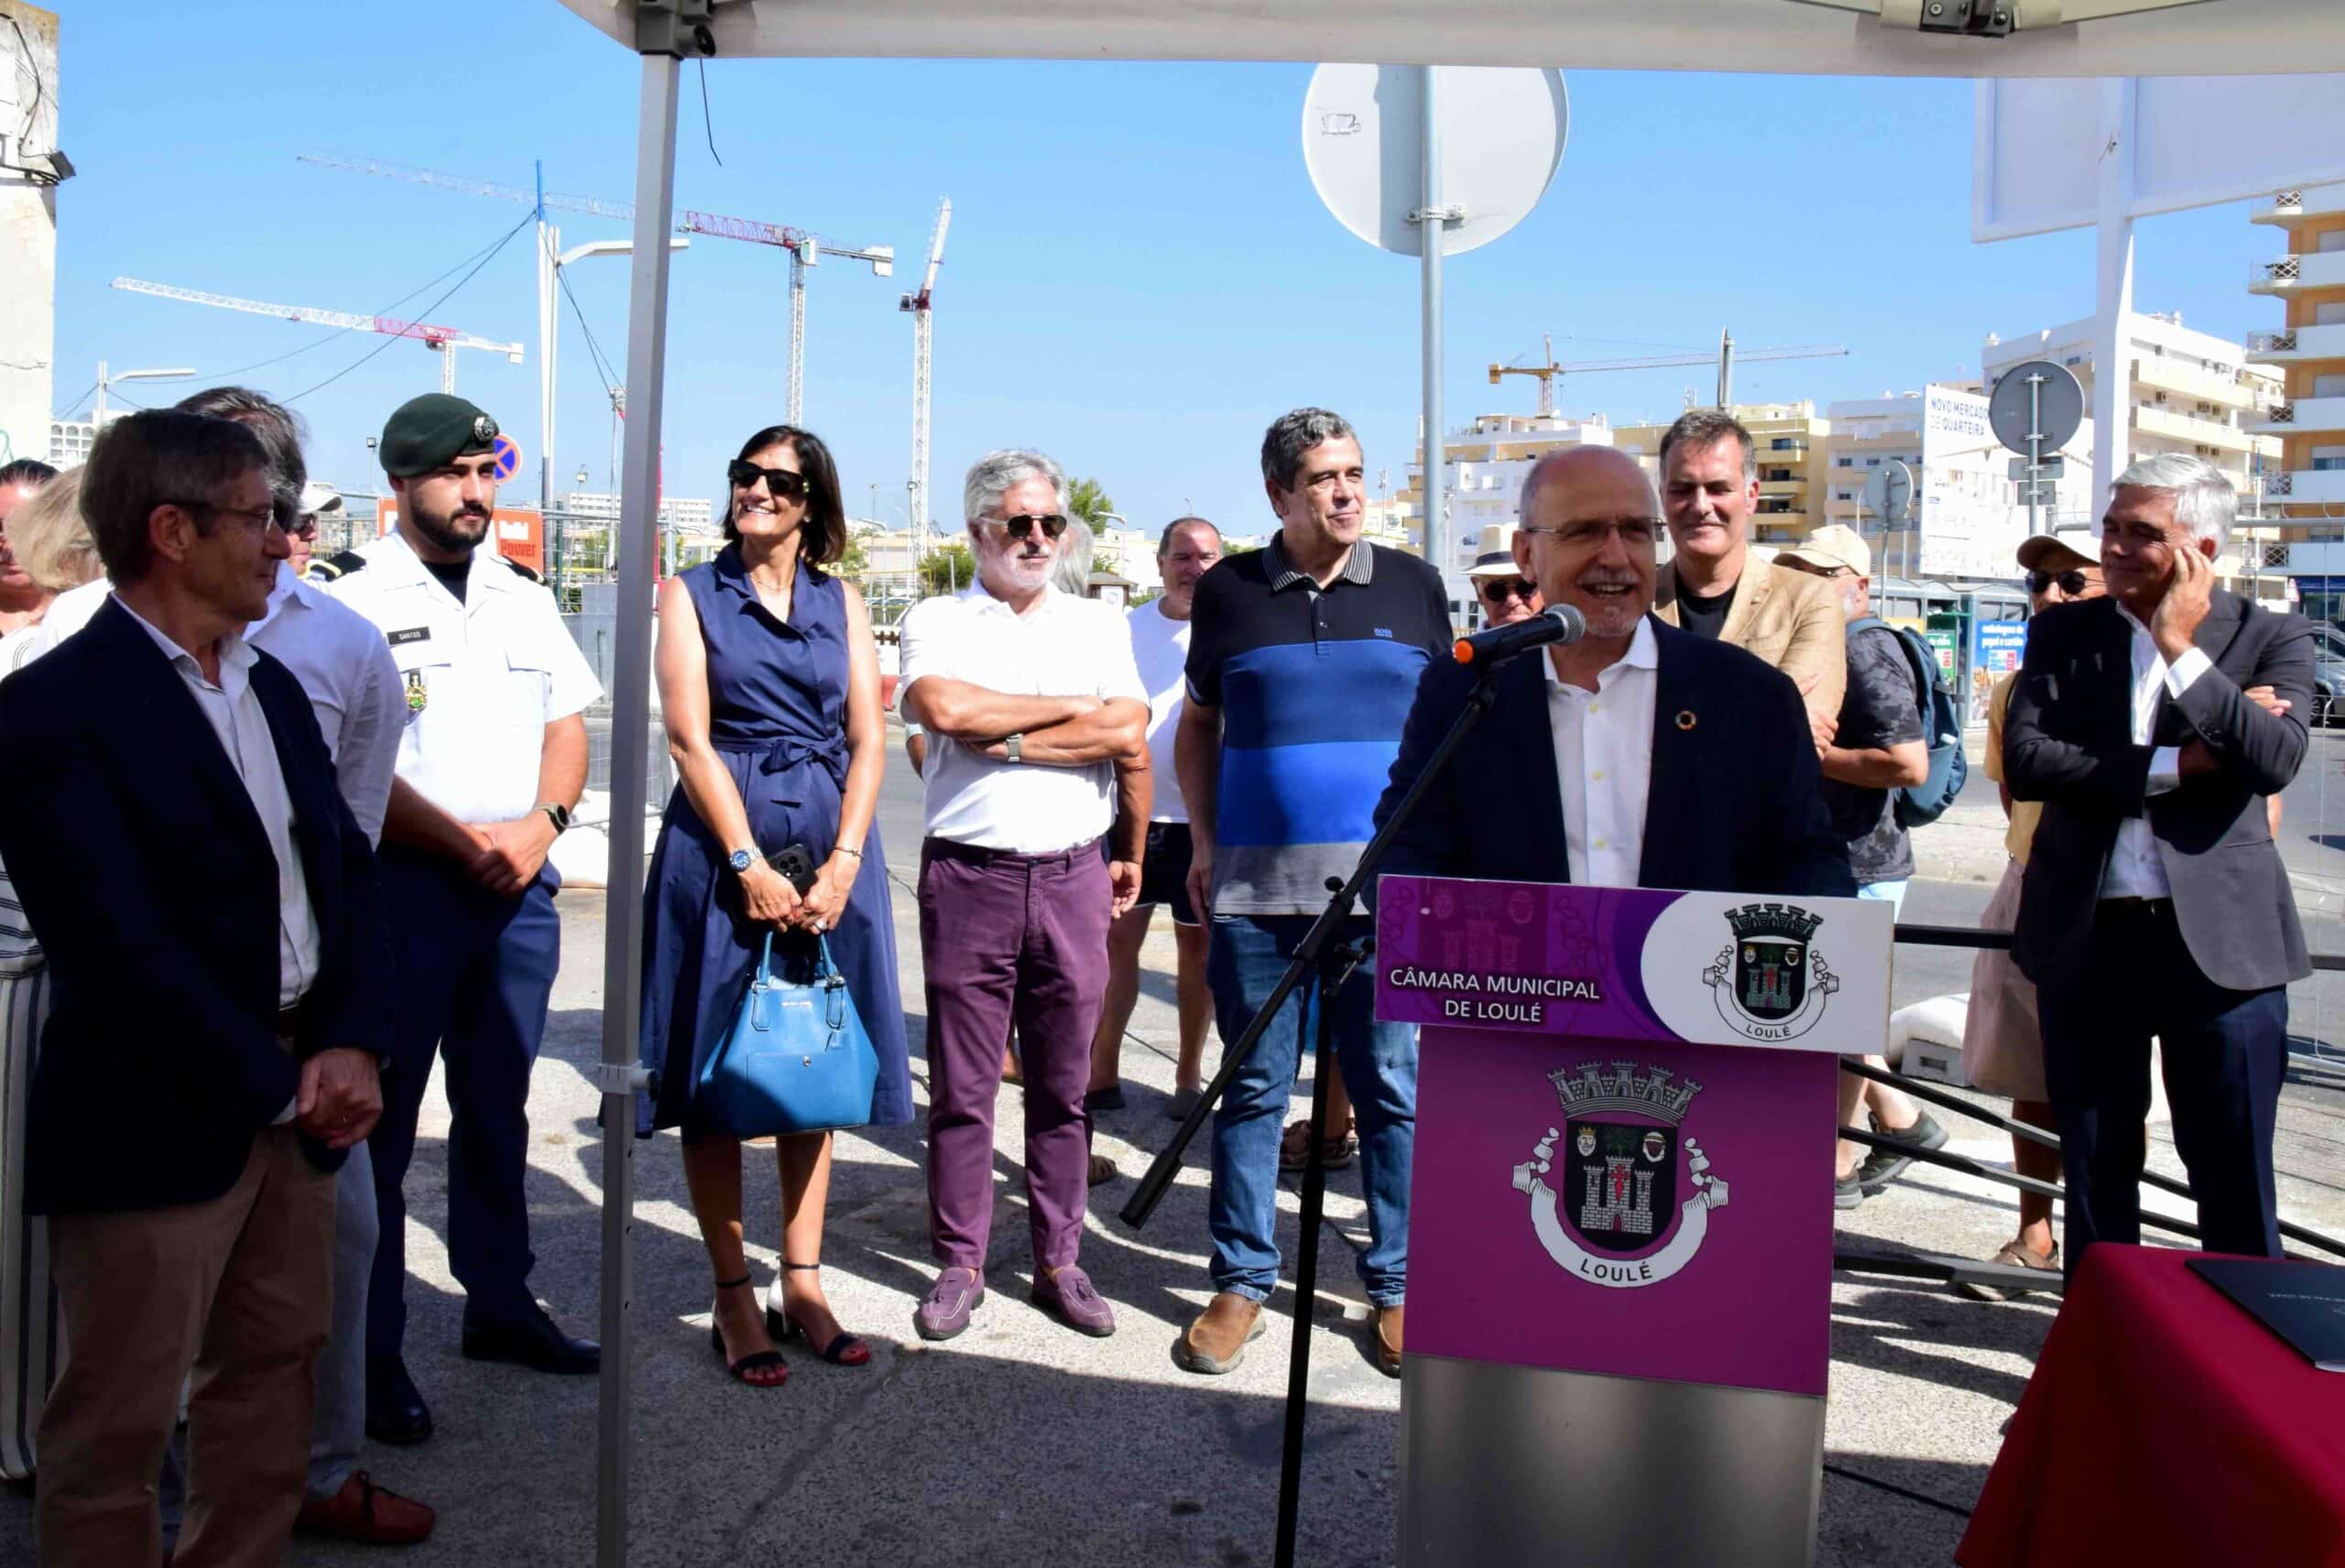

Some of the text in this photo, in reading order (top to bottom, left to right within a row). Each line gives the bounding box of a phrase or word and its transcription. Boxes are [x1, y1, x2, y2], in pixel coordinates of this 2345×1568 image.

[1931, 397, 1989, 419] NOVO MERCADO
[1943, 418, 1985, 435] QUARTEIRA
[500, 540, 537, 557] Power
[398, 631, 421, 640] SANTOS
[1391, 967, 1600, 999] CÂMARA MUNICIPAL
[1445, 999, 1542, 1022] DE LOULÉ
[1746, 1024, 1791, 1038] LOULÉ
[1580, 1258, 1652, 1281] LOULÉ
